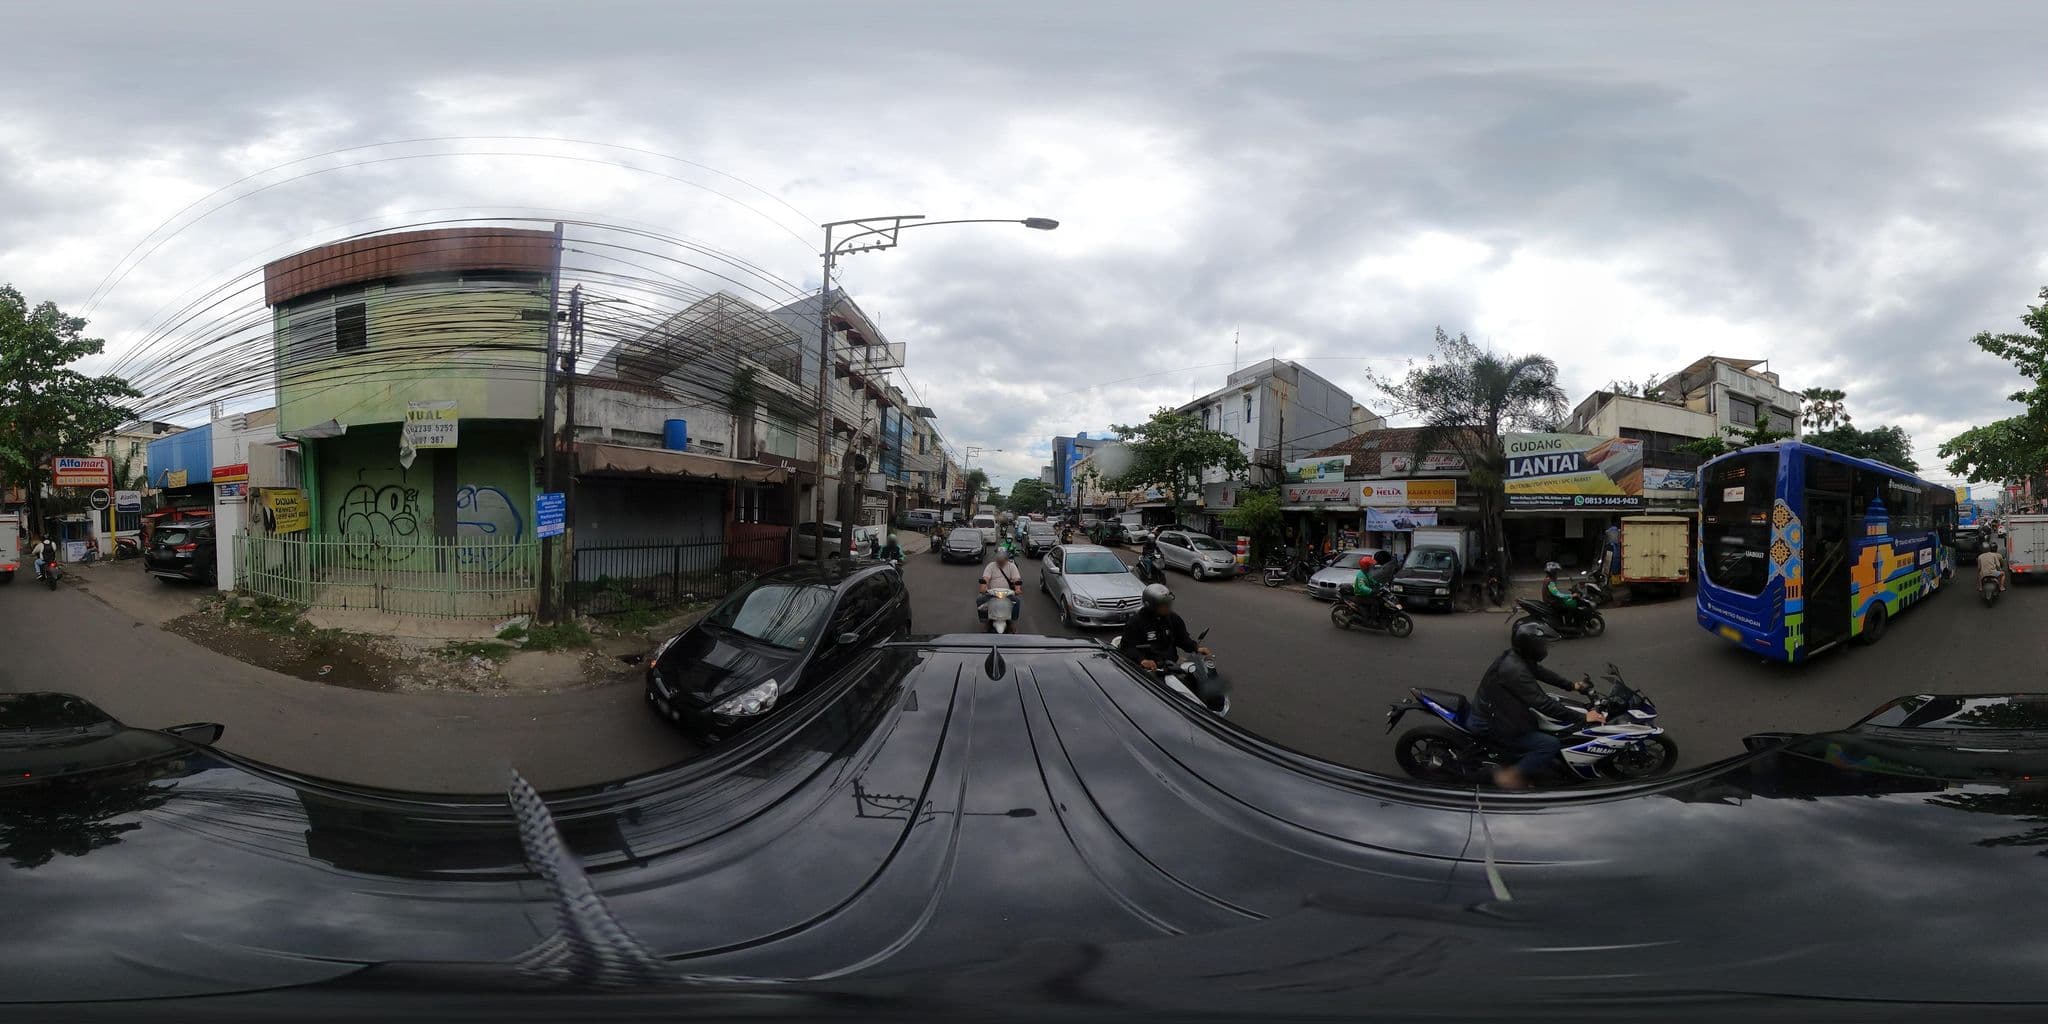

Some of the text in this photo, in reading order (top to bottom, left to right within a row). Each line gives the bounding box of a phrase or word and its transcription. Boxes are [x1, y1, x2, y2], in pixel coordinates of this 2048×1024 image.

[1511, 440, 1561, 453] GUDANG
[60, 459, 104, 467] Alfamart
[1510, 454, 1579, 477] LANTAI
[1376, 488, 1402, 496] HELIX
[1722, 609, 1736, 619] METRO
